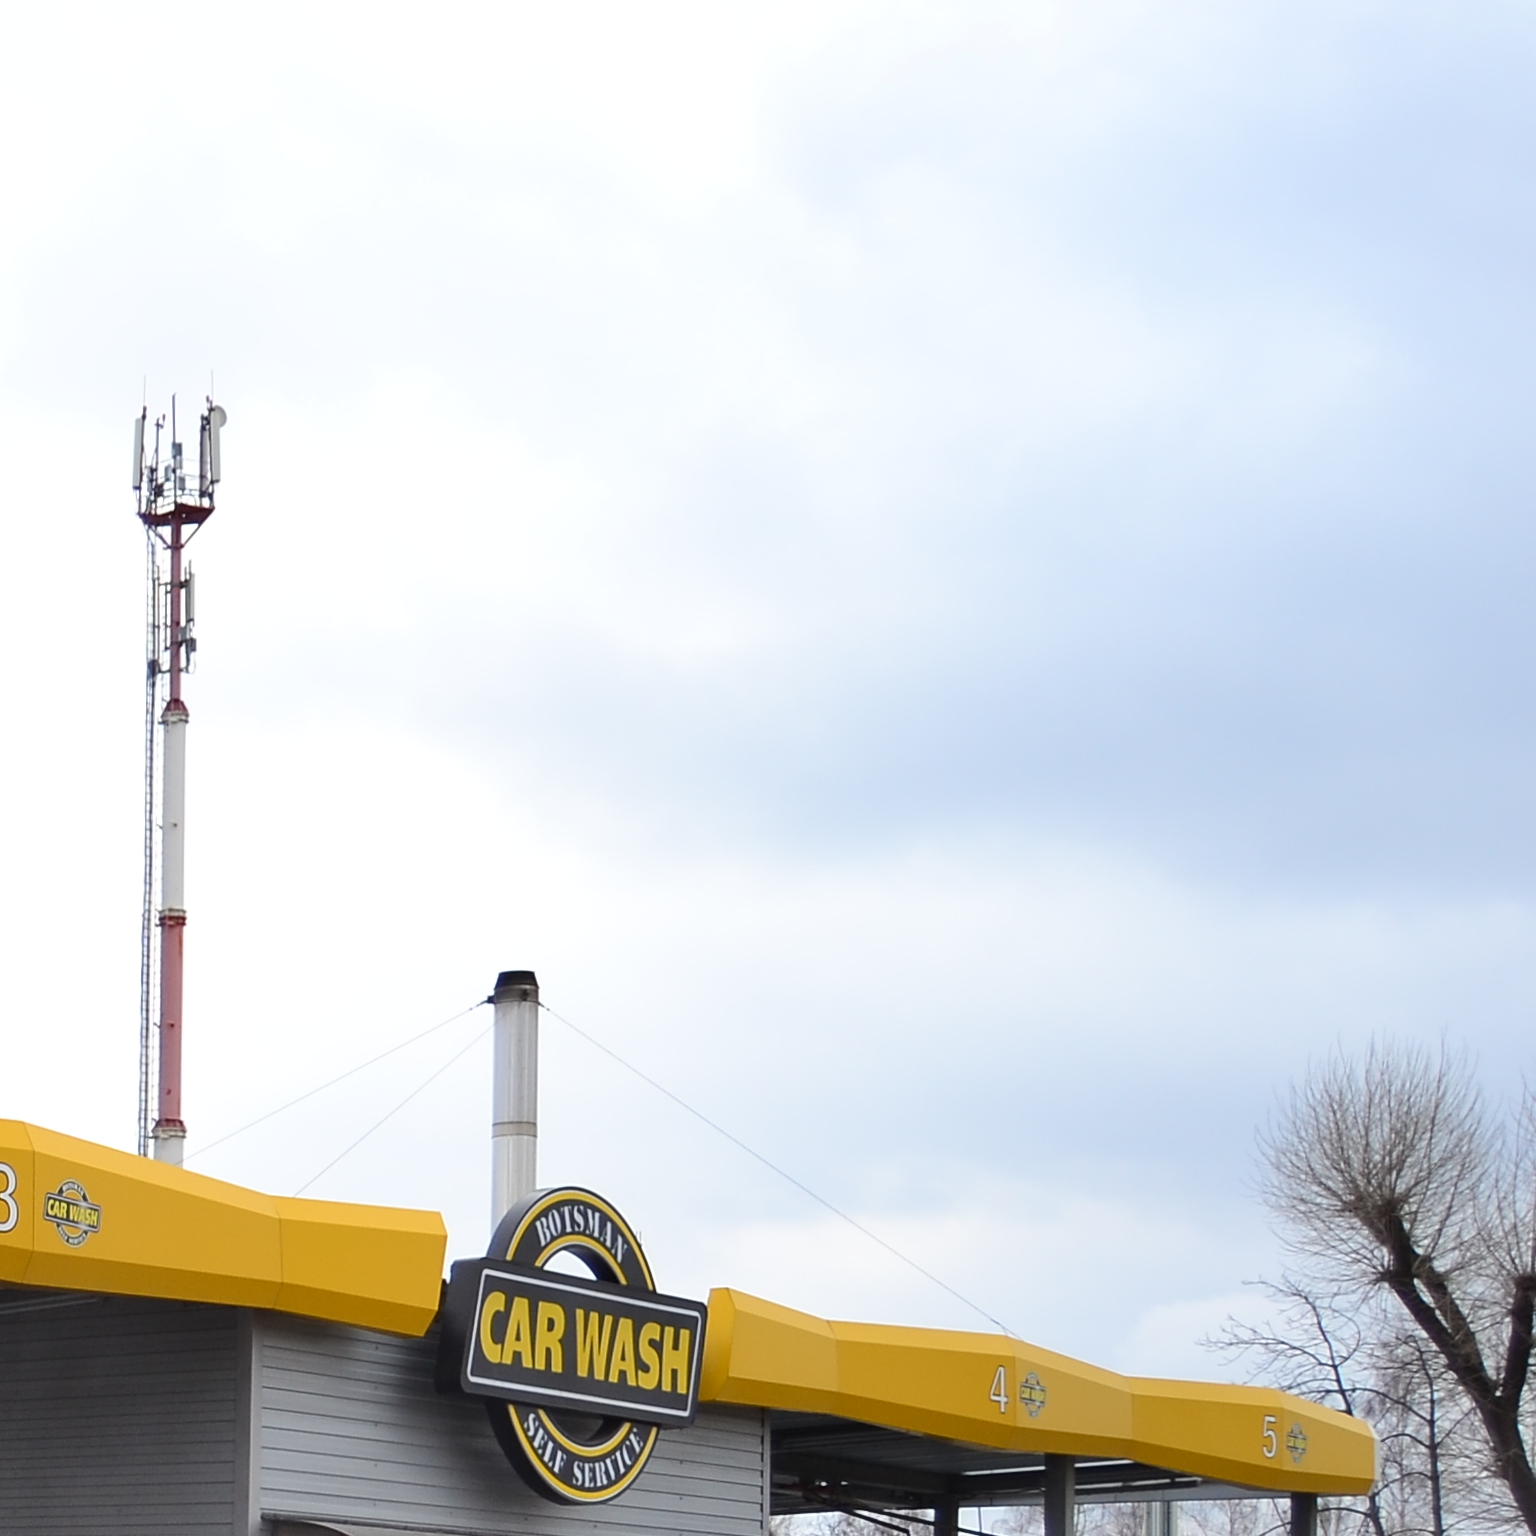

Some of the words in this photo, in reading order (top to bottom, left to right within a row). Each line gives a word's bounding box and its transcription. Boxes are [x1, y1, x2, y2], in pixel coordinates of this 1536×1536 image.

[48, 1199, 68, 1219] CAR
[69, 1204, 98, 1227] WASH
[534, 1204, 628, 1264] BOTSMAN
[479, 1290, 566, 1374] CAR
[575, 1308, 691, 1395] WASH
[989, 1365, 1009, 1414] 4
[523, 1411, 568, 1475] SELF
[572, 1427, 645, 1488] SERVICE
[1262, 1415, 1277, 1459] 5
